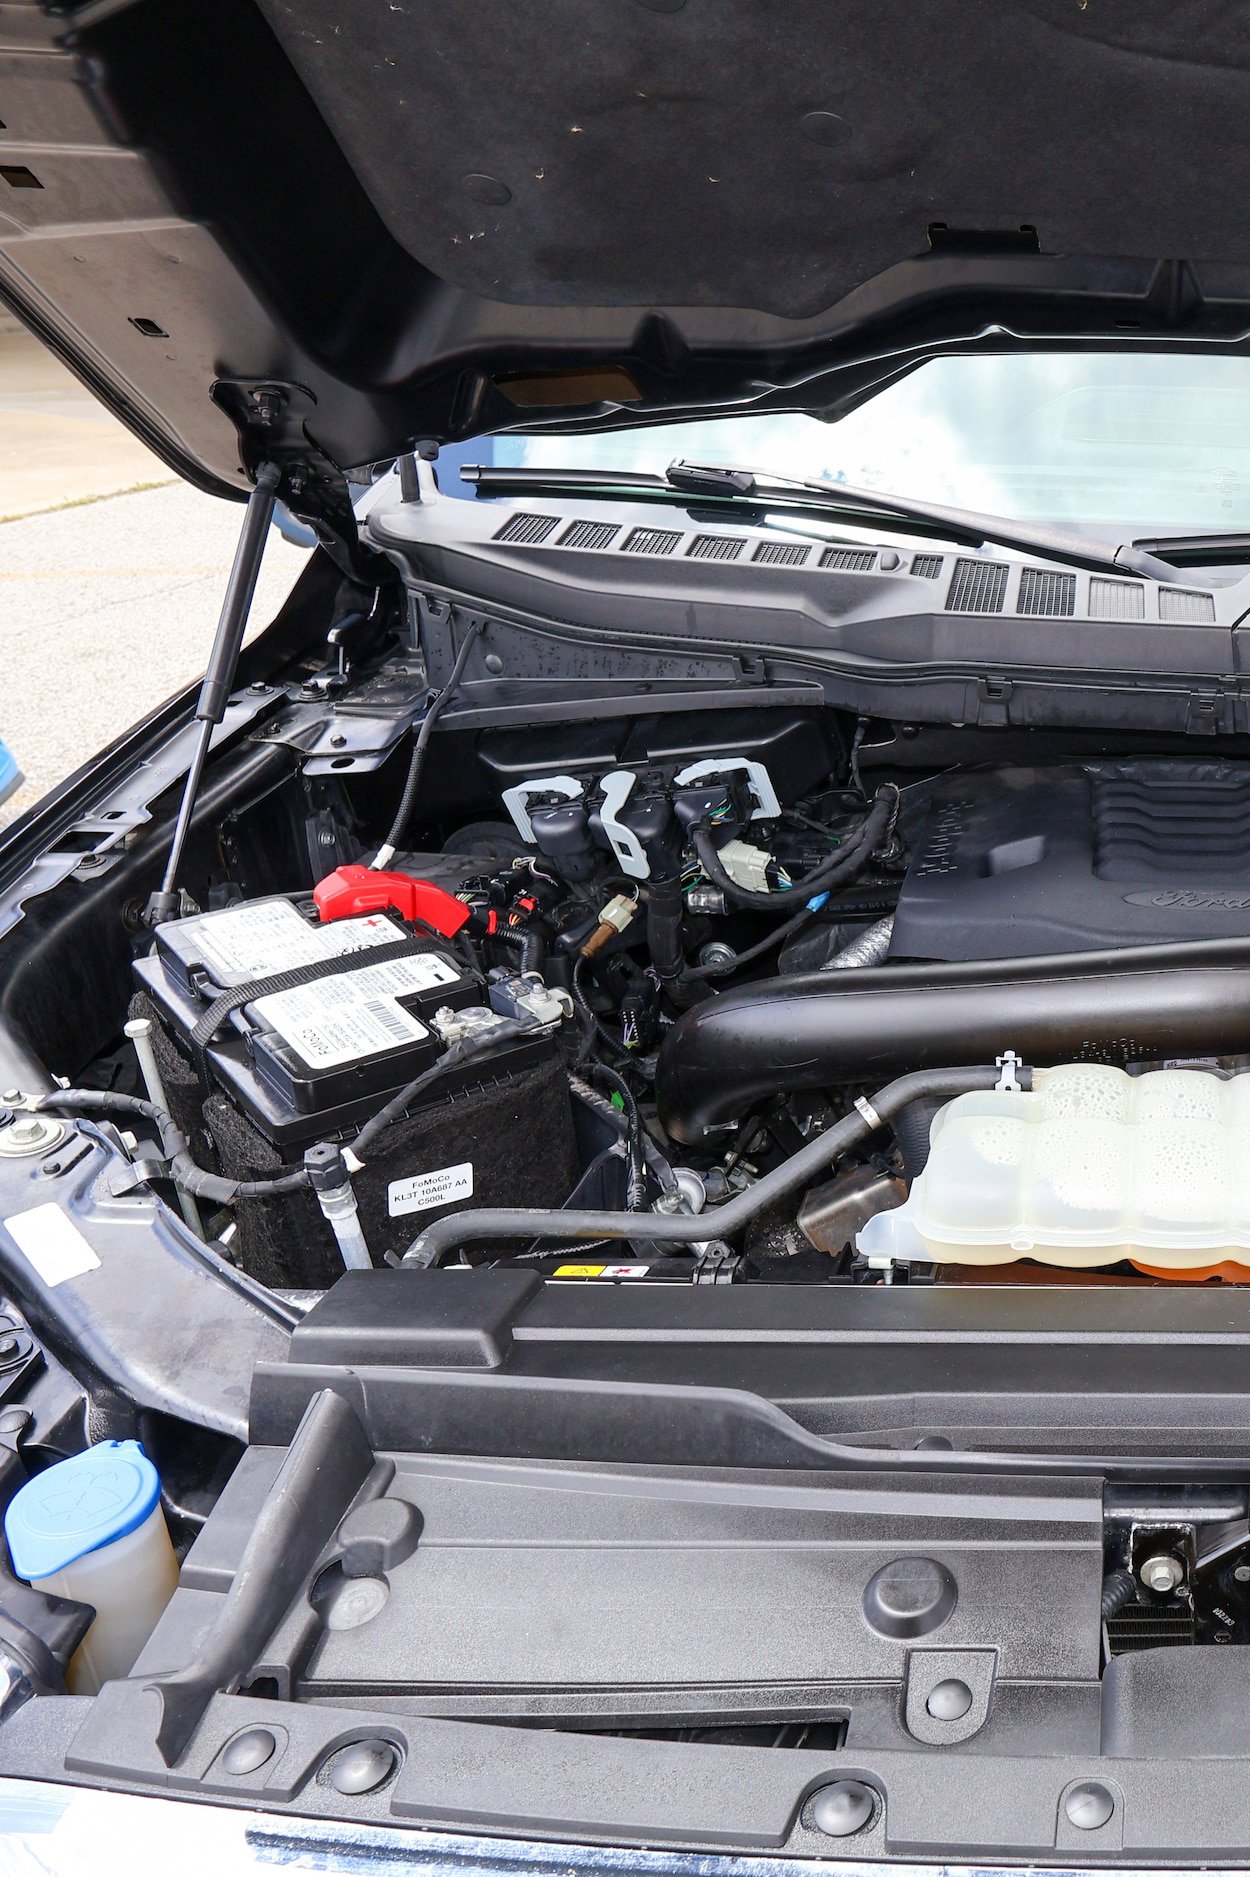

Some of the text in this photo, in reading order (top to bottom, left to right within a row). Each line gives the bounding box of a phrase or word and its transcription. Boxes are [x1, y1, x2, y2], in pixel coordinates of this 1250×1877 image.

[412, 1175, 450, 1189] FoMoCo
[394, 1178, 468, 1202] KL3T 10A687 AA
[417, 1194, 446, 1206] C500L
